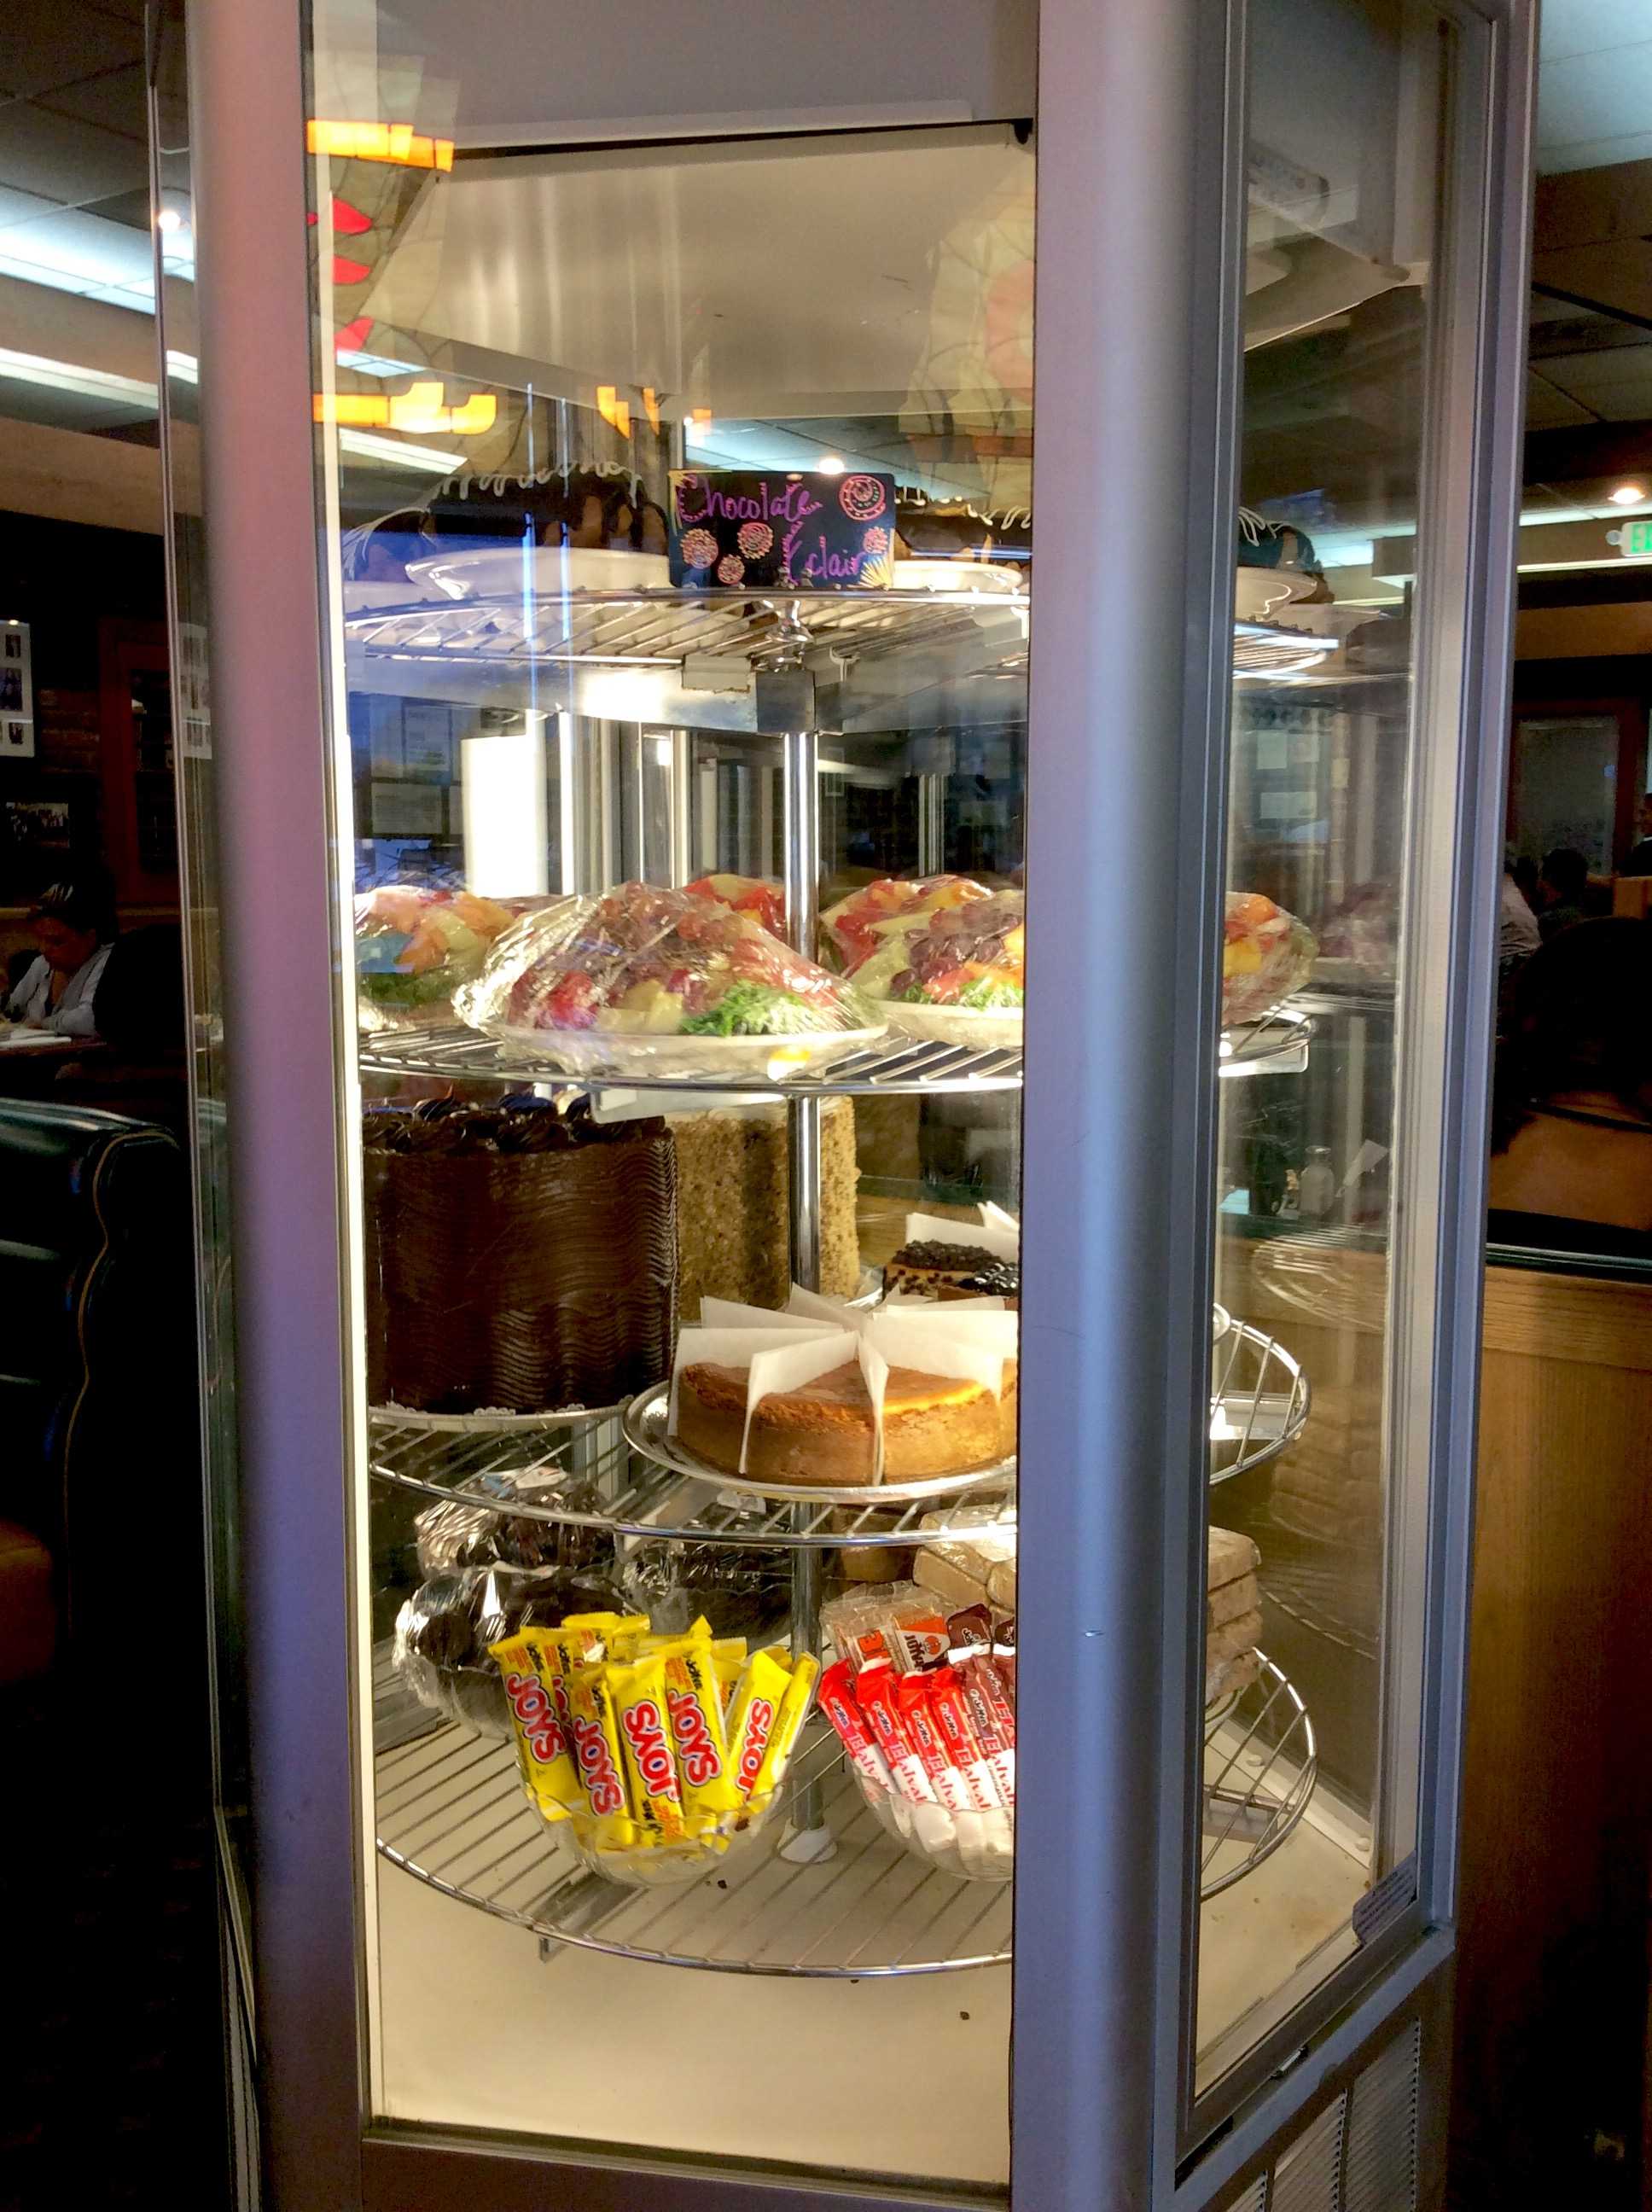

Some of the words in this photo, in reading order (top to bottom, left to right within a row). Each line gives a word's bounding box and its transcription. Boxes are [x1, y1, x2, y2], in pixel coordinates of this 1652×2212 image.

[677, 474, 823, 523] Chocolate
[506, 1674, 567, 1764] JOYS
[573, 1717, 625, 1817] JOYS
[623, 1699, 683, 1802] JOYS
[666, 1688, 721, 1787] JOYS
[736, 1698, 774, 1802] JOYS
[927, 1753, 957, 1810] Halva
